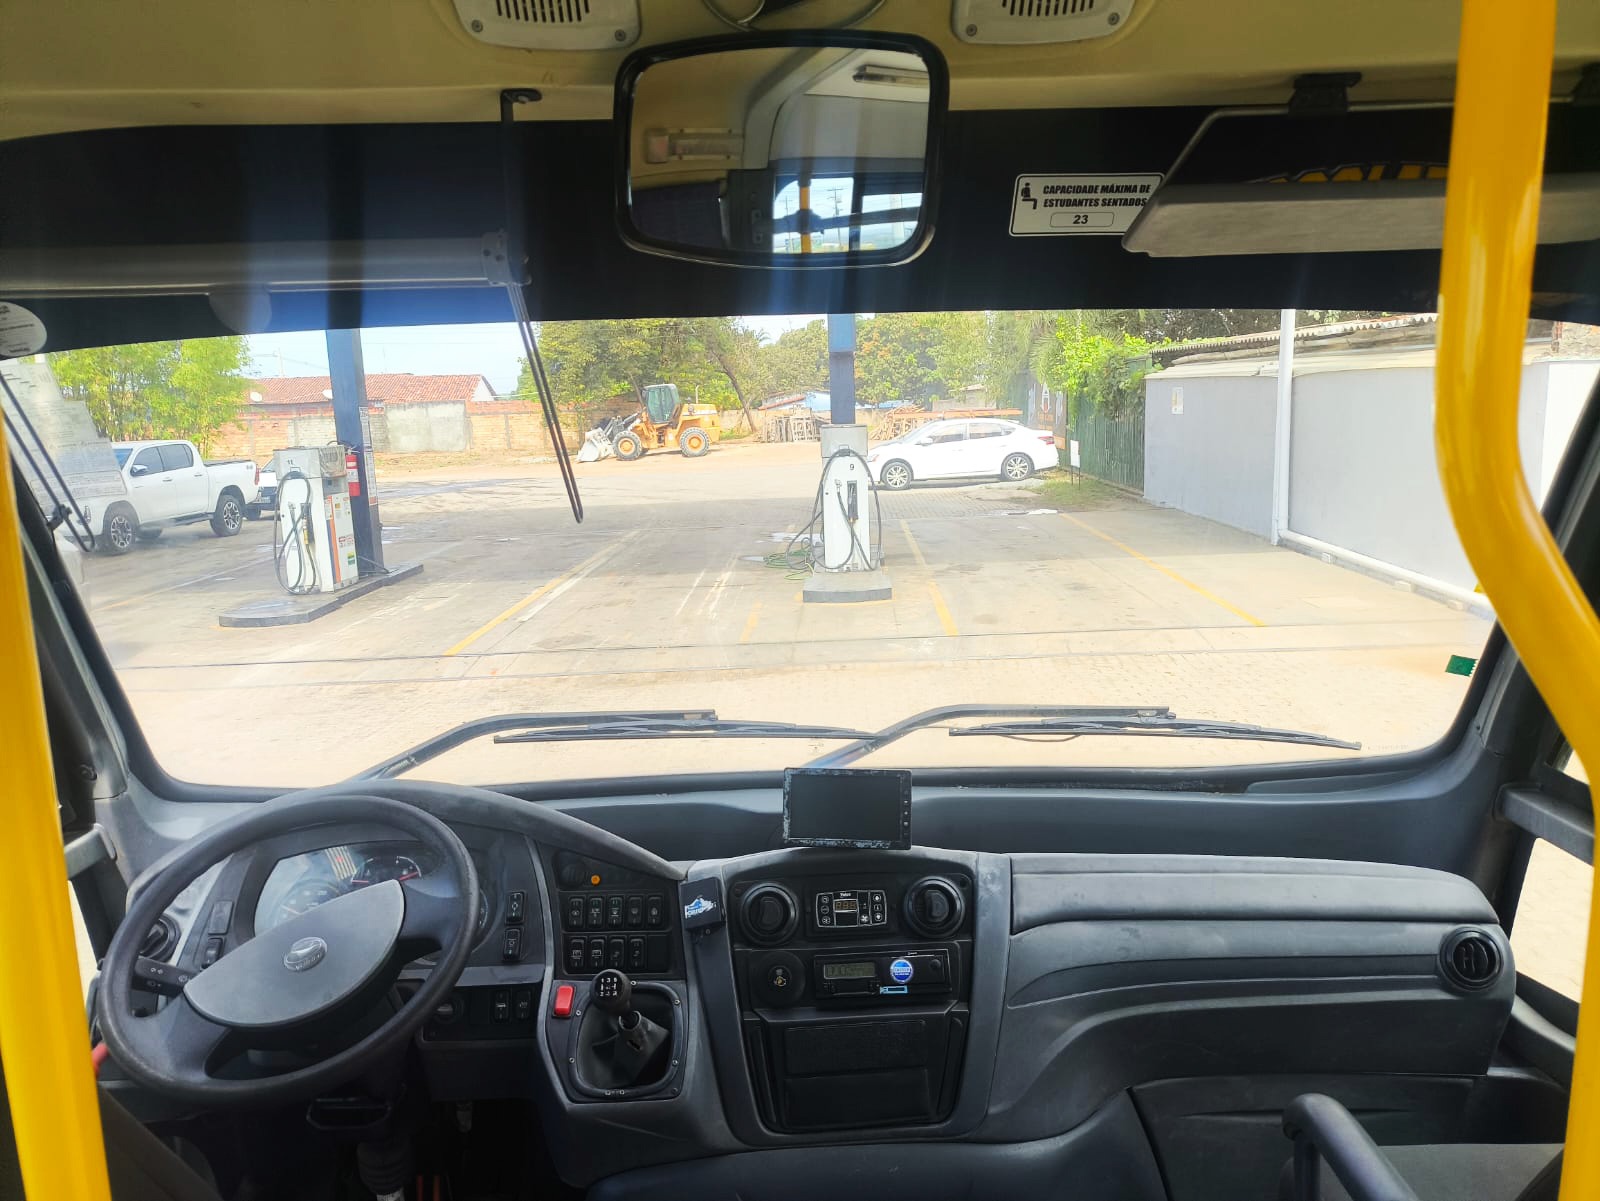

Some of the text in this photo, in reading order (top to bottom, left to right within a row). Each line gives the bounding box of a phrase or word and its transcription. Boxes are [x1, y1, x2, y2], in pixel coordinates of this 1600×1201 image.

[1043, 183, 1151, 194] CAPACIDADE MÁXIMA DE
[1043, 198, 1100, 208] ESTUDANTES
[1072, 214, 1089, 225] 23
